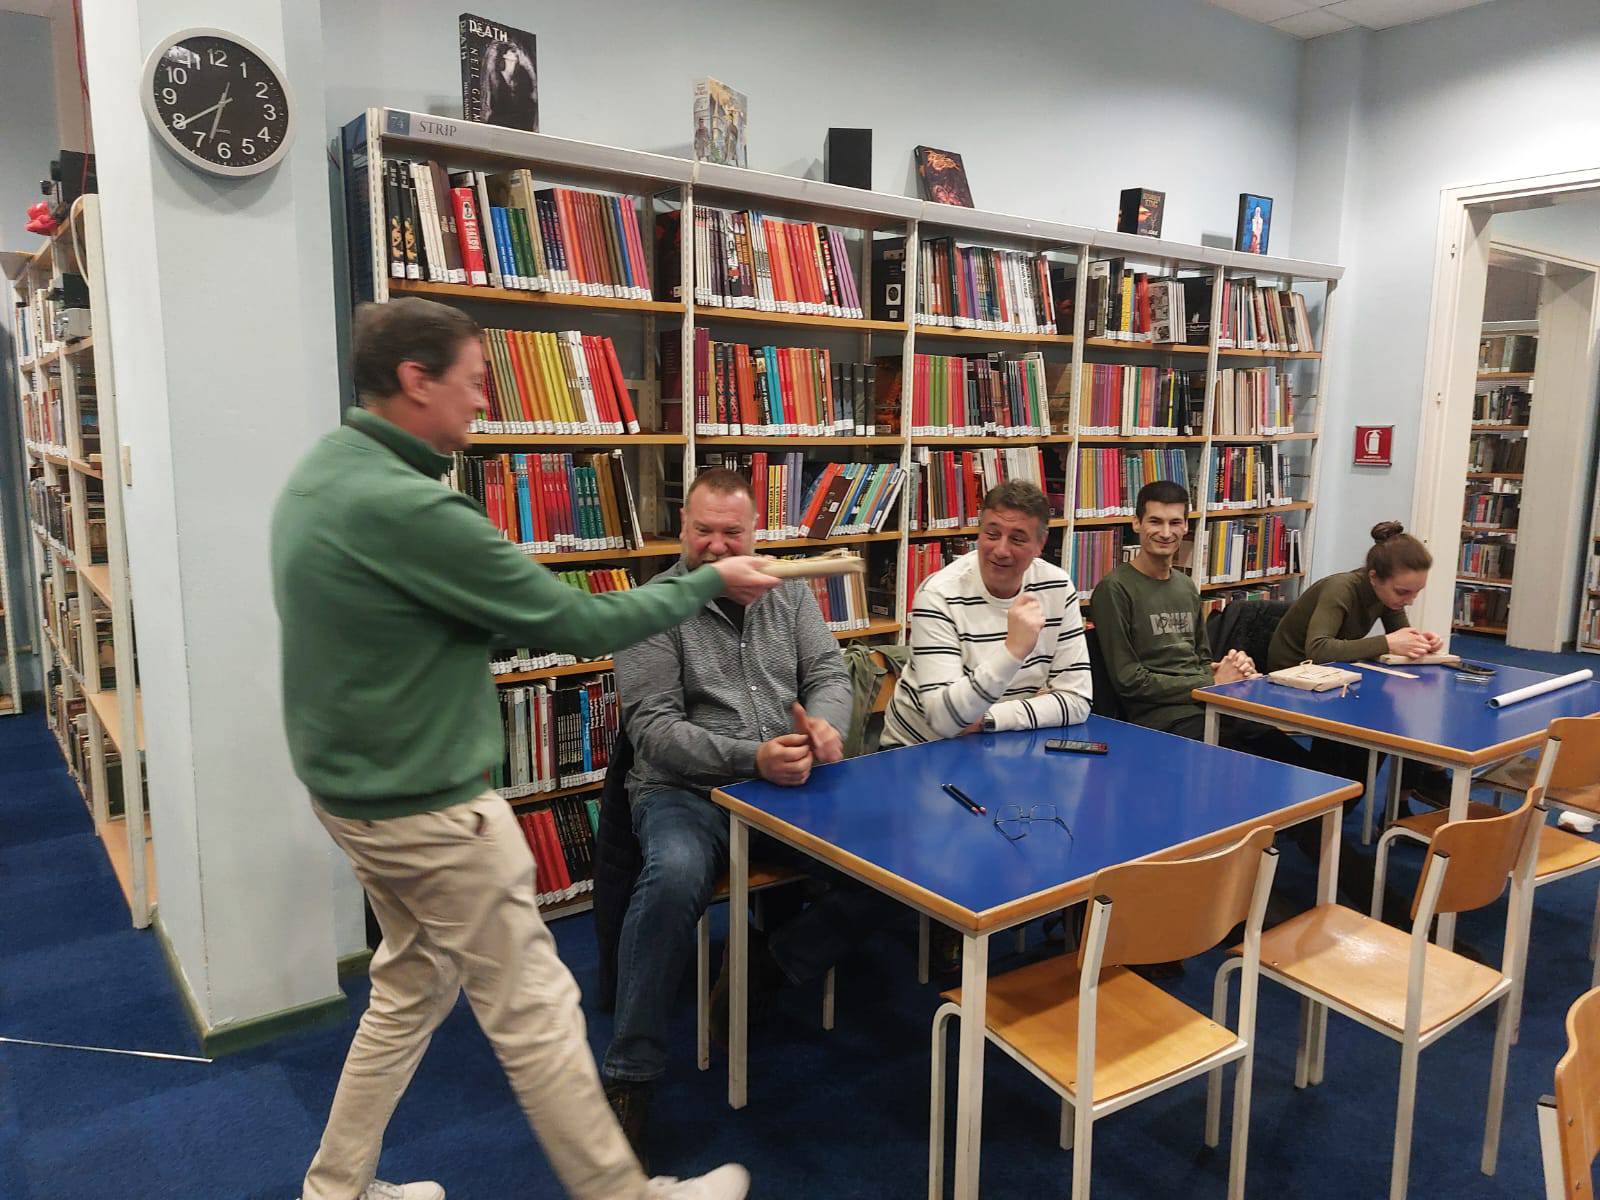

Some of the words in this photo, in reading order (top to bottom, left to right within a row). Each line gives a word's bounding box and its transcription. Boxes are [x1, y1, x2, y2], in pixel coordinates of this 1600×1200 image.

[469, 19, 508, 42] DEATH
[207, 48, 229, 68] 12
[240, 61, 248, 79] 1
[470, 47, 480, 79] NEIL
[165, 66, 187, 85] 10
[162, 88, 177, 105] 9
[255, 82, 269, 99] 2
[263, 104, 277, 121] 3
[471, 88, 481, 122] GAIM
[172, 113, 187, 130] 8
[419, 121, 457, 137] STRIP
[192, 131, 207, 148] 7
[257, 126, 271, 143] 4
[217, 142, 231, 159] 6
[242, 138, 256, 155] 5
